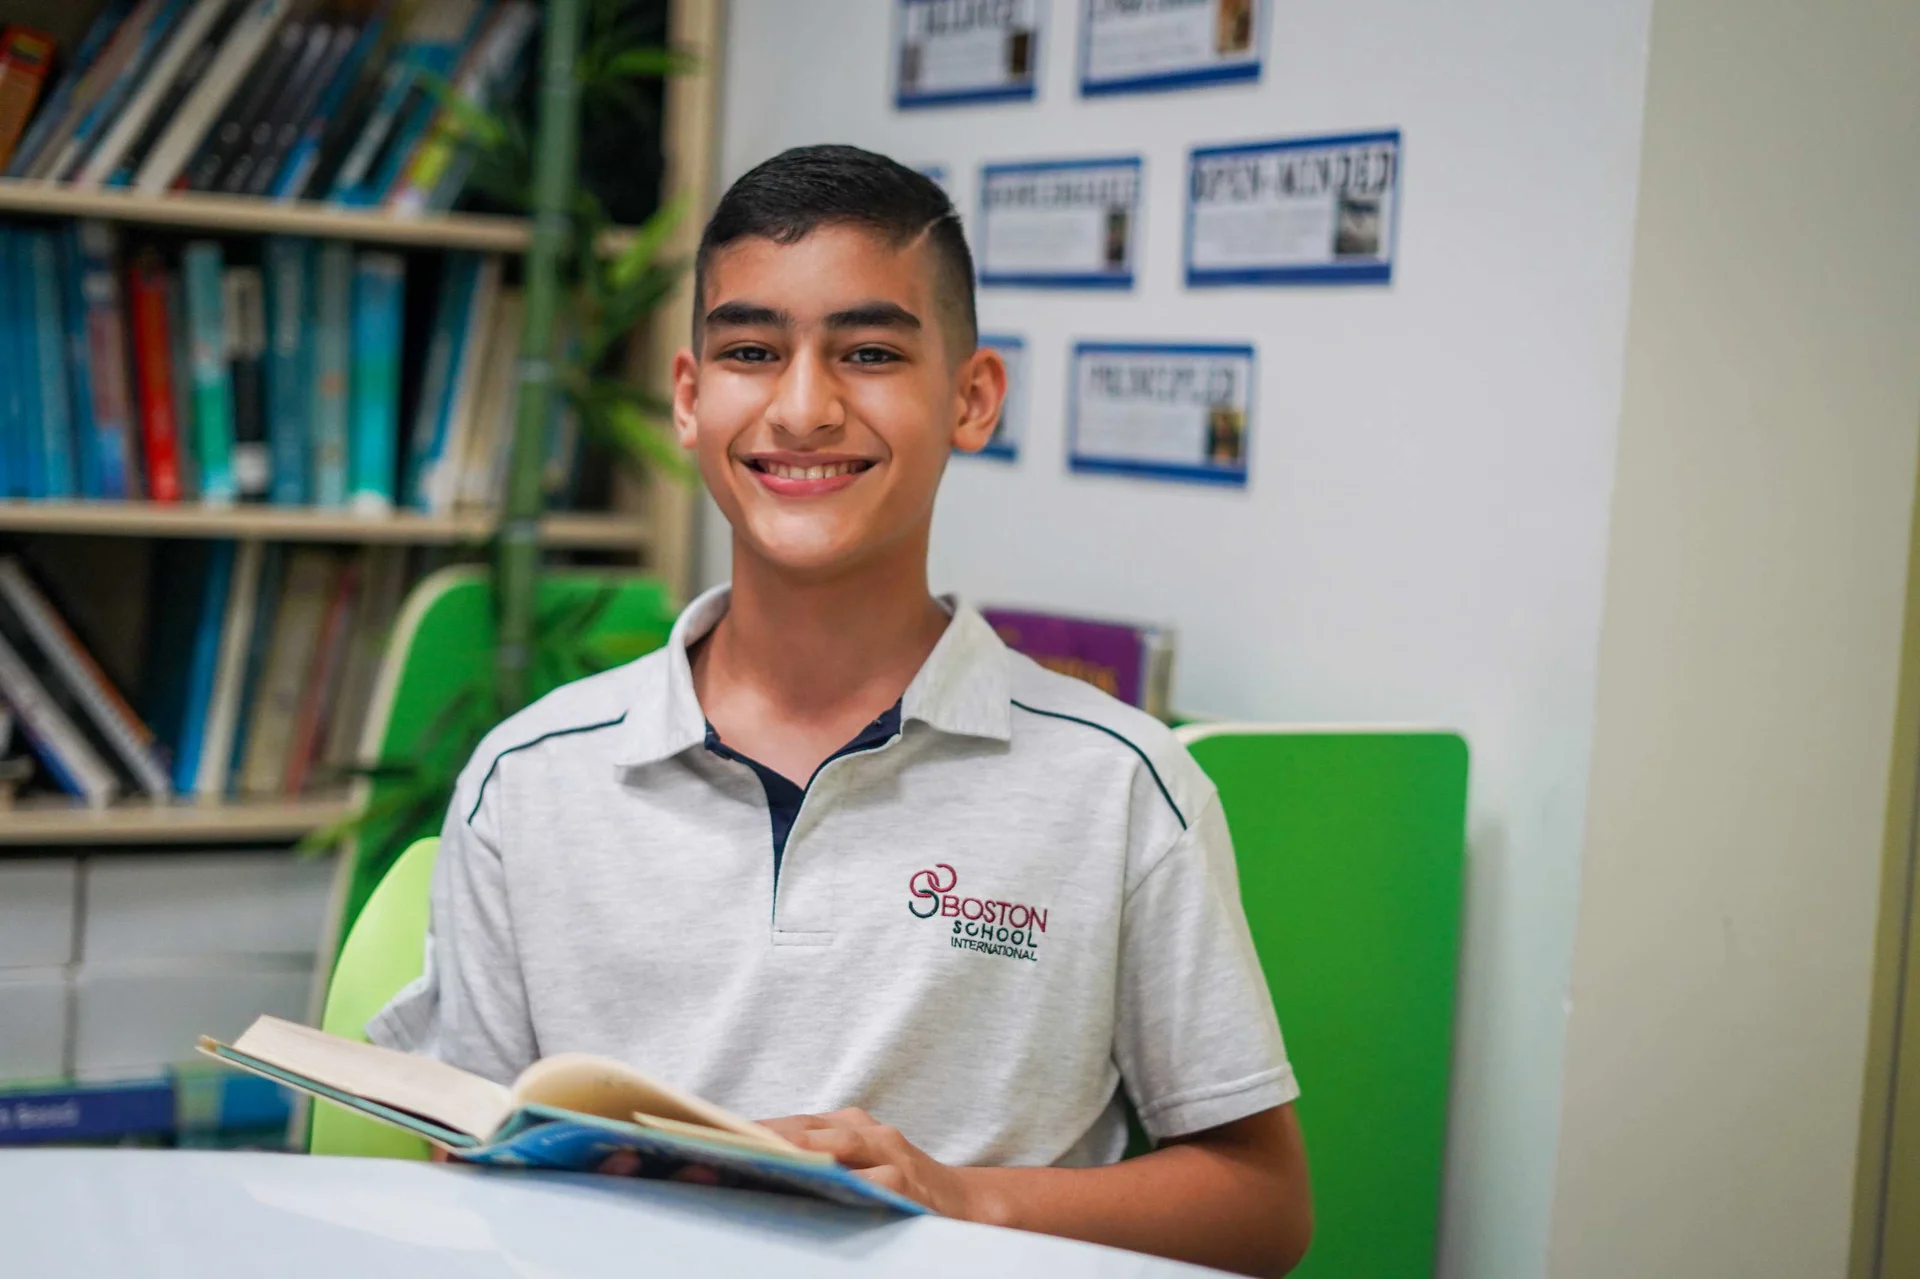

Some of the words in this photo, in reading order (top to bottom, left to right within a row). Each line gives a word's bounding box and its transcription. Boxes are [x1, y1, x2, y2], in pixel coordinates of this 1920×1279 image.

[941, 895, 1047, 933] BOSTON
[953, 920, 1037, 948] SCHOOL
[951, 936, 1037, 961] INTERNATIONAL
